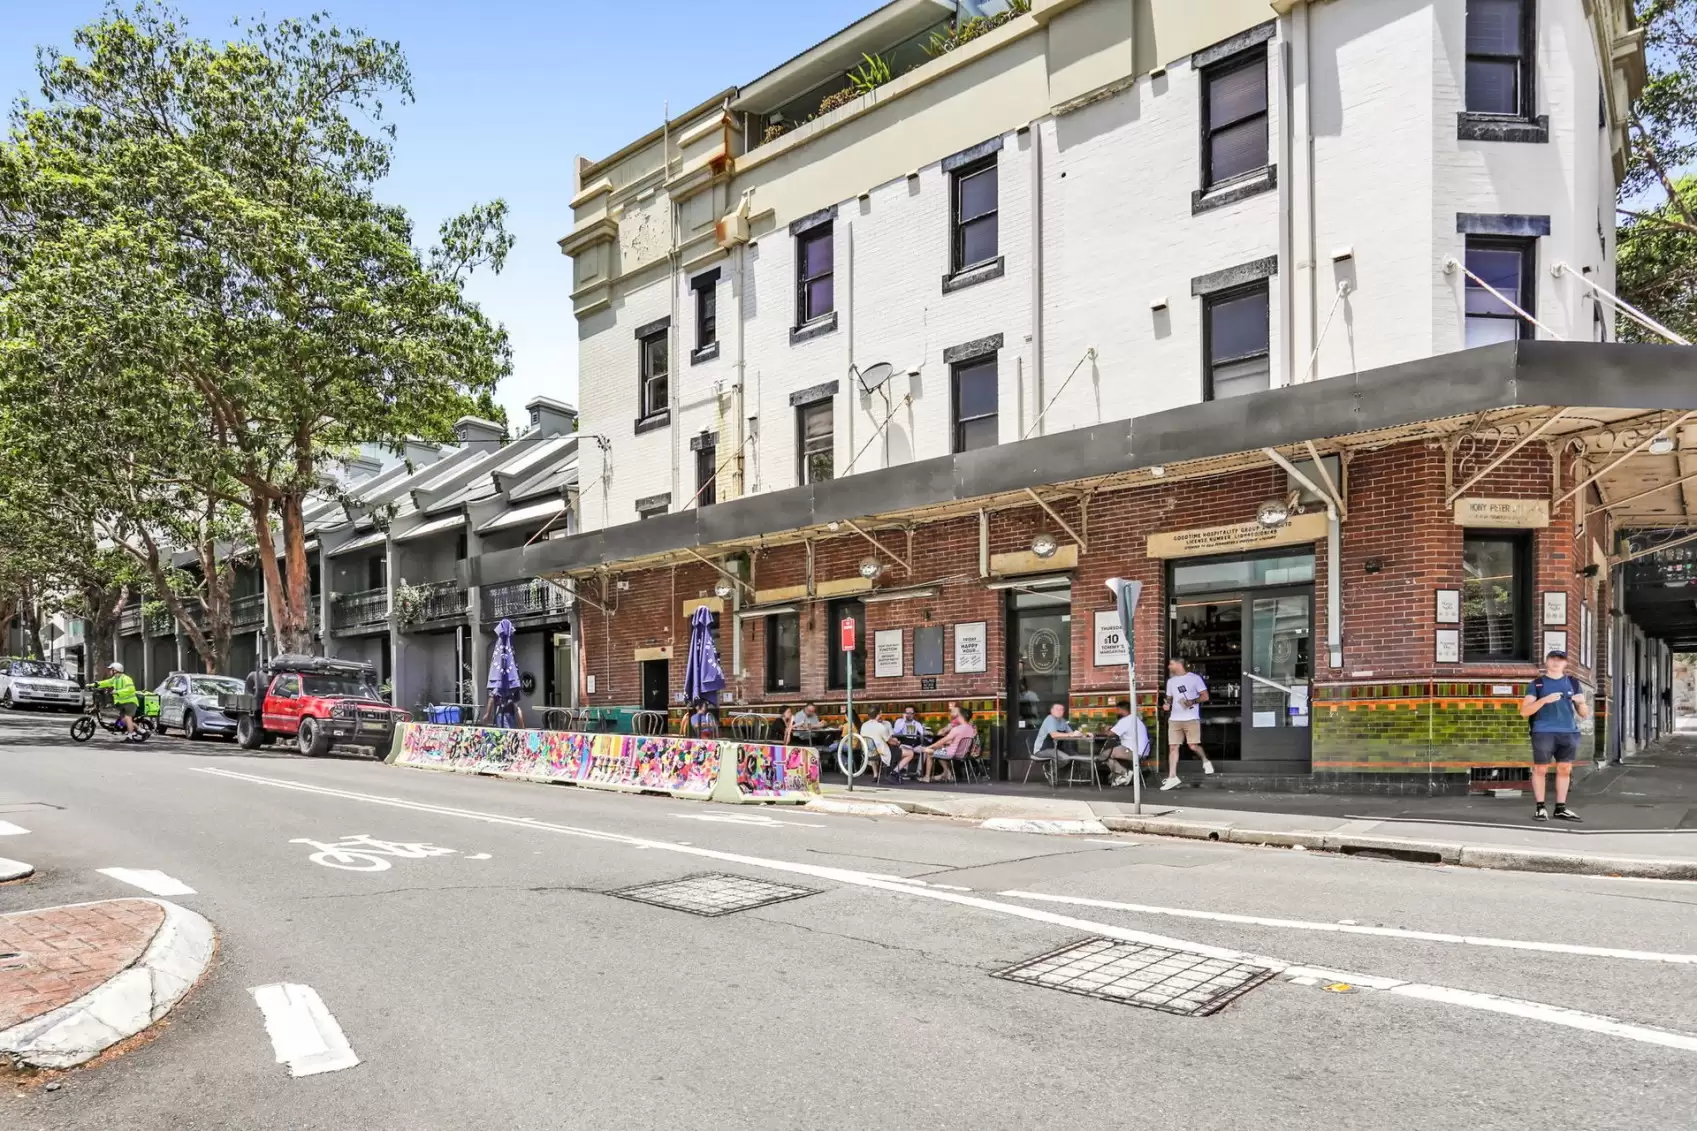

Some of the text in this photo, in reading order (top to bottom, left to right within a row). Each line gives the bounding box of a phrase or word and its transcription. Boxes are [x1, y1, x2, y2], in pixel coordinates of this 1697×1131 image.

[1490, 503, 1510, 512] PETER
[1173, 533, 1201, 541] GOODTIME
[1203, 528, 1238, 537] HOSPITALITY
[1186, 537, 1208, 545] LICENSE
[1104, 634, 1119, 644] $10
